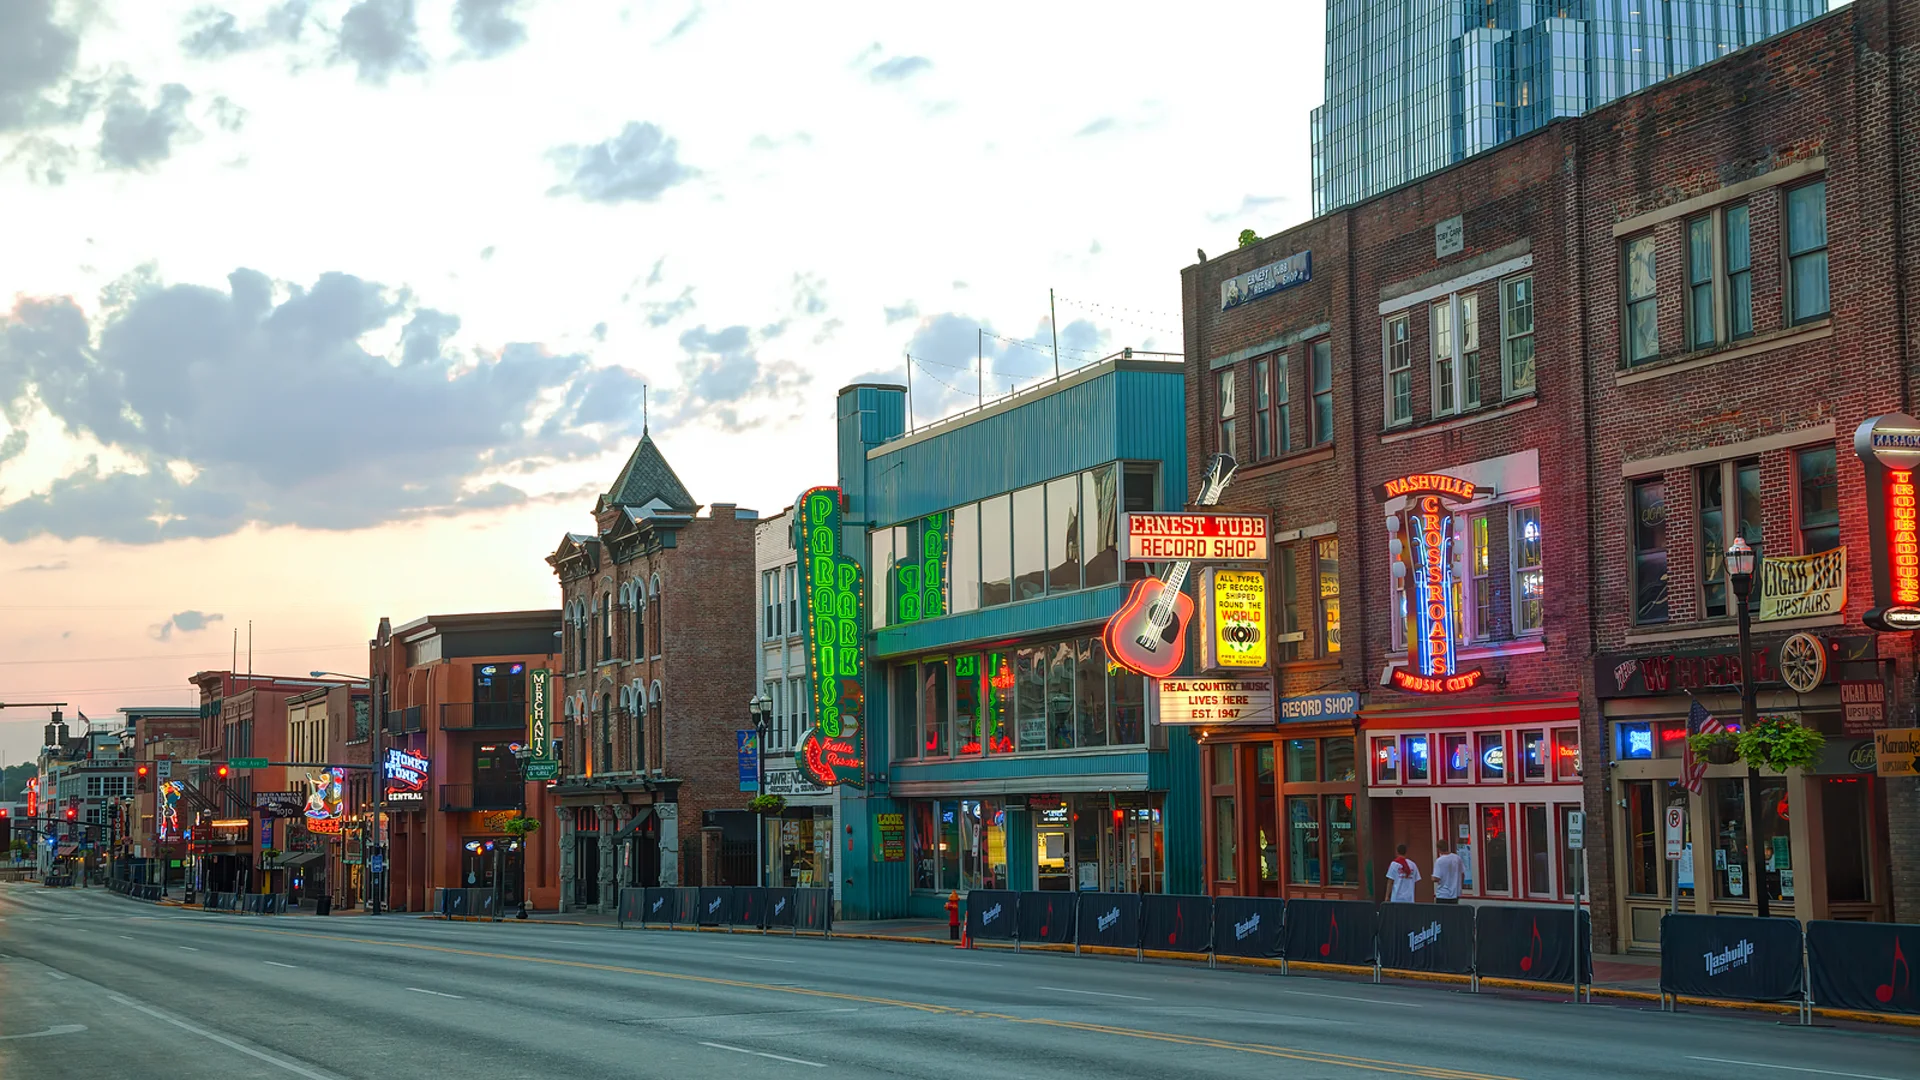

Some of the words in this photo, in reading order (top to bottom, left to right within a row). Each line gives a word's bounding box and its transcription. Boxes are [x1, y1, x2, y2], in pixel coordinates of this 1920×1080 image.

[1875, 434, 1920, 447] KARAOK
[1384, 474, 1477, 499] NASHVILLE
[1131, 515, 1206, 535] ERNEST
[1215, 517, 1265, 536] TUBB
[1141, 538, 1207, 557] RECORD
[1214, 539, 1256, 558] SHOP
[1219, 575, 1233, 583] ALL
[1237, 575, 1260, 584] TYPES
[1764, 559, 1808, 597] CIGAR
[1811, 551, 1843, 591] BAR
[1216, 583, 1227, 591] OF
[1229, 584, 1264, 592] RECORDS
[1423, 495, 1448, 675] CROSSROADS
[1219, 600, 1244, 609] ROUND
[1248, 601, 1262, 609] THE
[1225, 593, 1256, 601] SHIPPED
[1775, 593, 1831, 617] UPSTAIRS
[811, 494, 841, 738] PARADISE
[837, 563, 858, 677] PARK
[1221, 610, 1261, 622] WORLD
[1638, 652, 1779, 691] WHEEL
[1163, 682, 1189, 692] REAL
[1192, 682, 1238, 692] COUNTRY
[1241, 682, 1270, 692] MUSIC
[1841, 684, 1866, 703] CIGAR
[1866, 683, 1885, 702] BAR
[1188, 695, 1218, 705] LIVES
[1223, 695, 1249, 705] HERE
[1281, 700, 1323, 718] RECORD
[1325, 696, 1354, 715] SHOP
[533, 673, 545, 757] MERCHANTS
[1191, 709, 1214, 719] EST.
[1218, 709, 1241, 718] 1947
[1847, 706, 1881, 718] UPSTAIRS
[822, 737, 855, 754] Trailer
[389, 749, 429, 773] HONKY
[827, 753, 859, 768] Resort
[1882, 760, 1911, 772] UPSTAIRS
[384, 762, 419, 784] TONK
[764, 770, 808, 786] LAWRENC
[388, 792, 423, 801] CENTRAL
[877, 813, 904, 825] LOOK
[783, 821, 800, 835] 45
[783, 834, 800, 842] RPM
[1407, 920, 1442, 953] Nashville
[1703, 938, 1754, 977] Nashville
[1713, 965, 1729, 975] MUSIC
[1733, 959, 1744, 969] CITY
